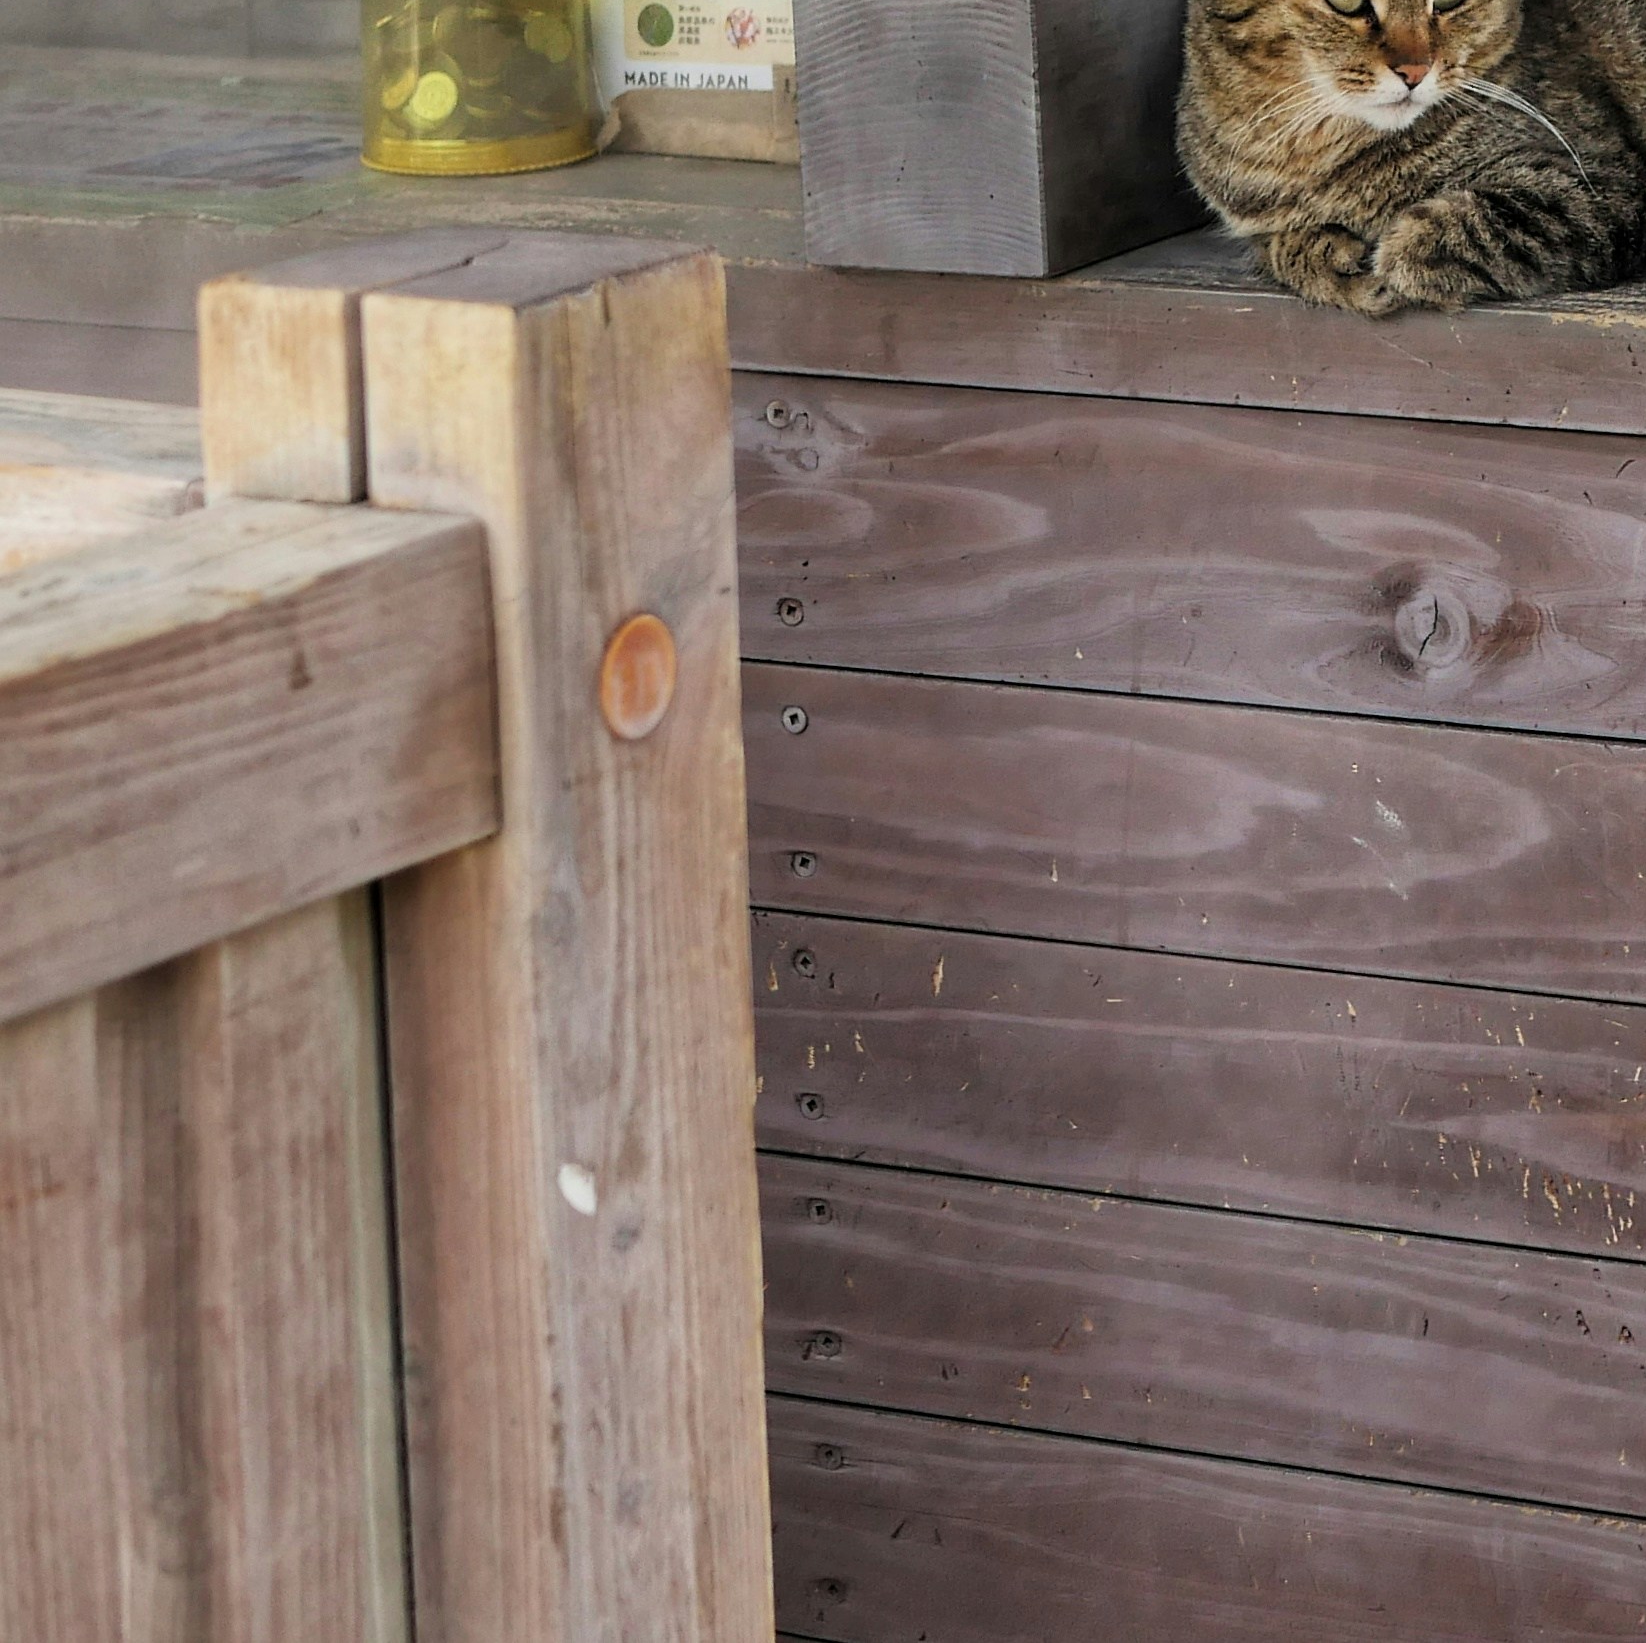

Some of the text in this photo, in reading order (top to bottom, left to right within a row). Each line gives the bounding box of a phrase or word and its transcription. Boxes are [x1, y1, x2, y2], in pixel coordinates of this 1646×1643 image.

[625, 71, 748, 91] MADE IN JAPAN
